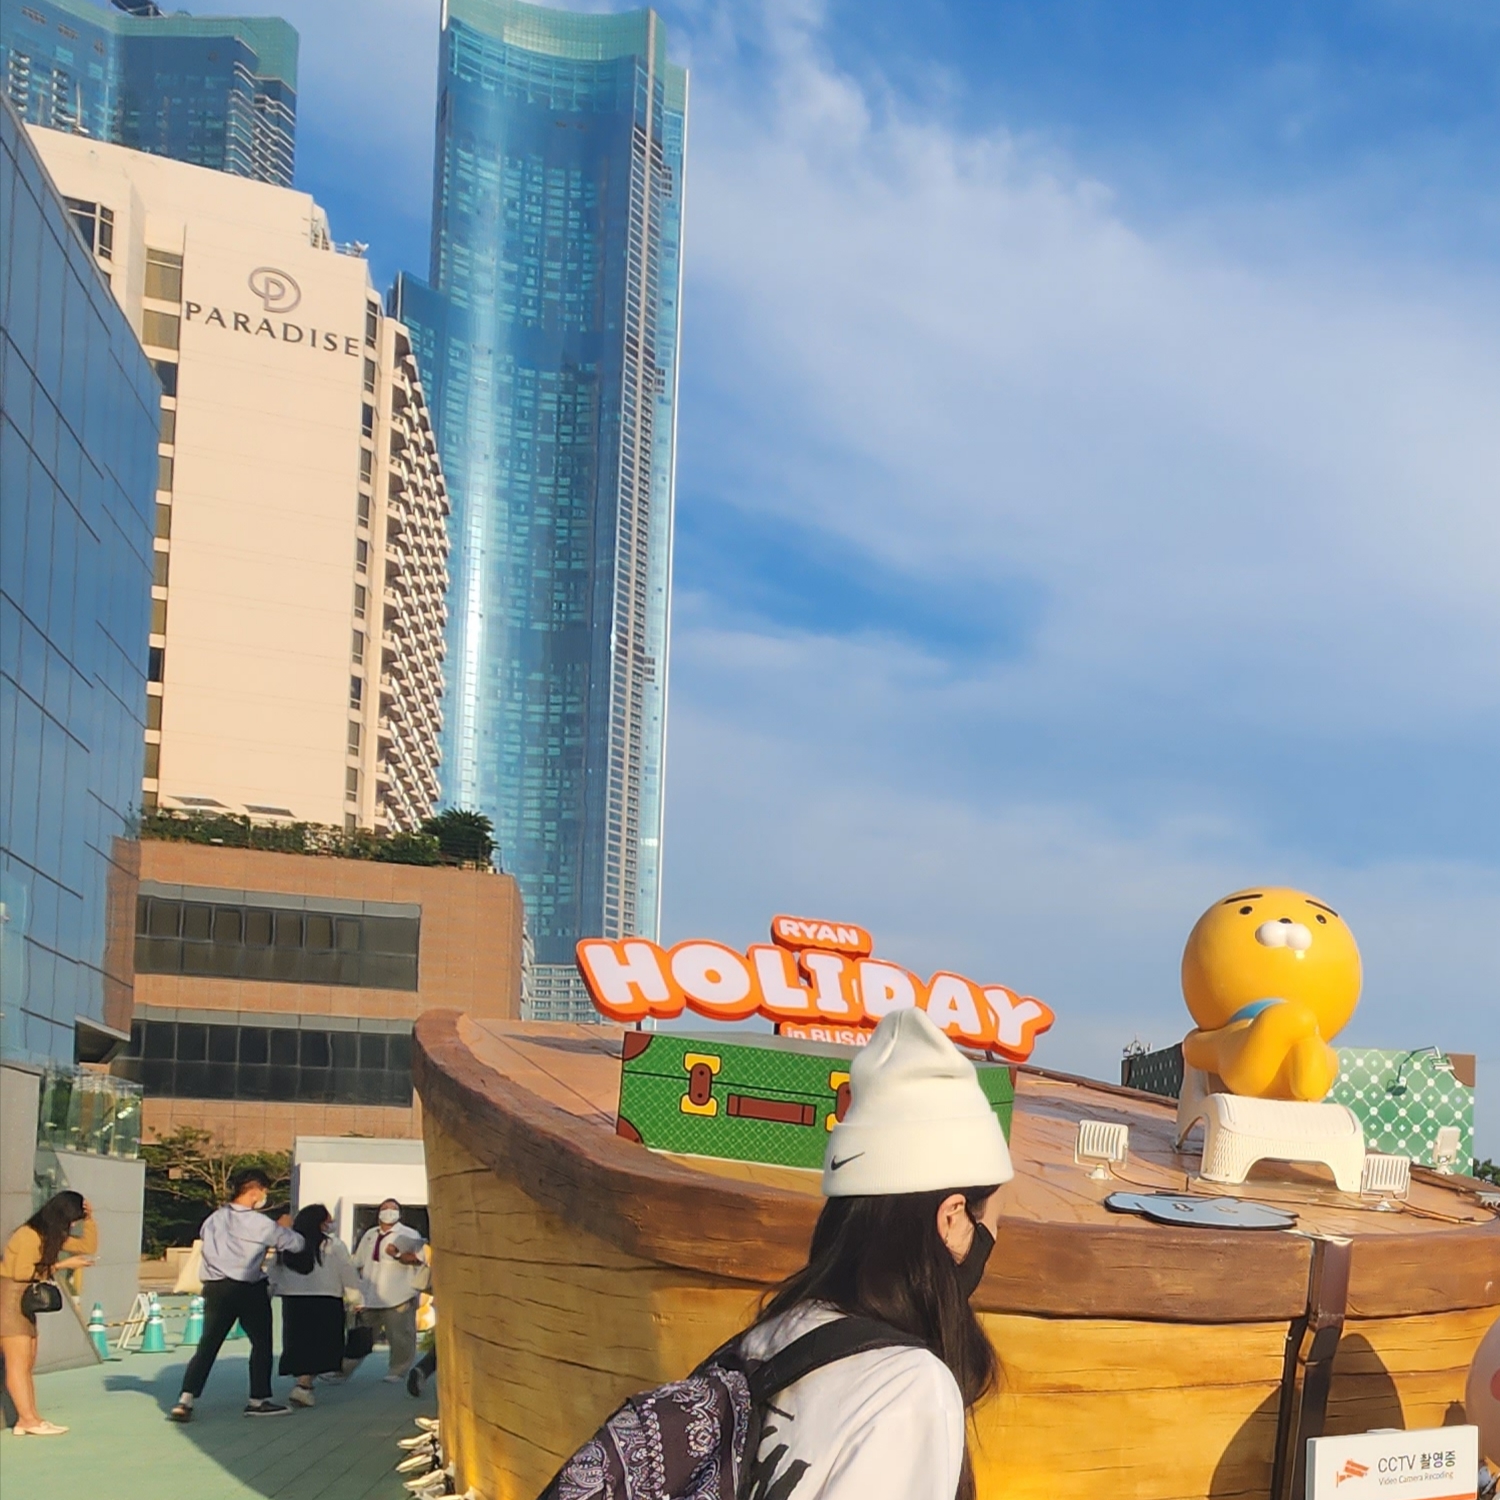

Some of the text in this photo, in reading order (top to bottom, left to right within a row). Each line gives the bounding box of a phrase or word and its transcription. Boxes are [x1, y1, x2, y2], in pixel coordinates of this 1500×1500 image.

[184, 300, 360, 358] PARADISE
[779, 919, 859, 946] RYAN
[583, 942, 1044, 1048] HOLIDAY
[810, 1028, 874, 1047] BUSA
[1378, 1450, 1456, 1473] CCTV 촬영중
[1378, 1477, 1398, 1486] Video
[1399, 1474, 1423, 1484] Camera
